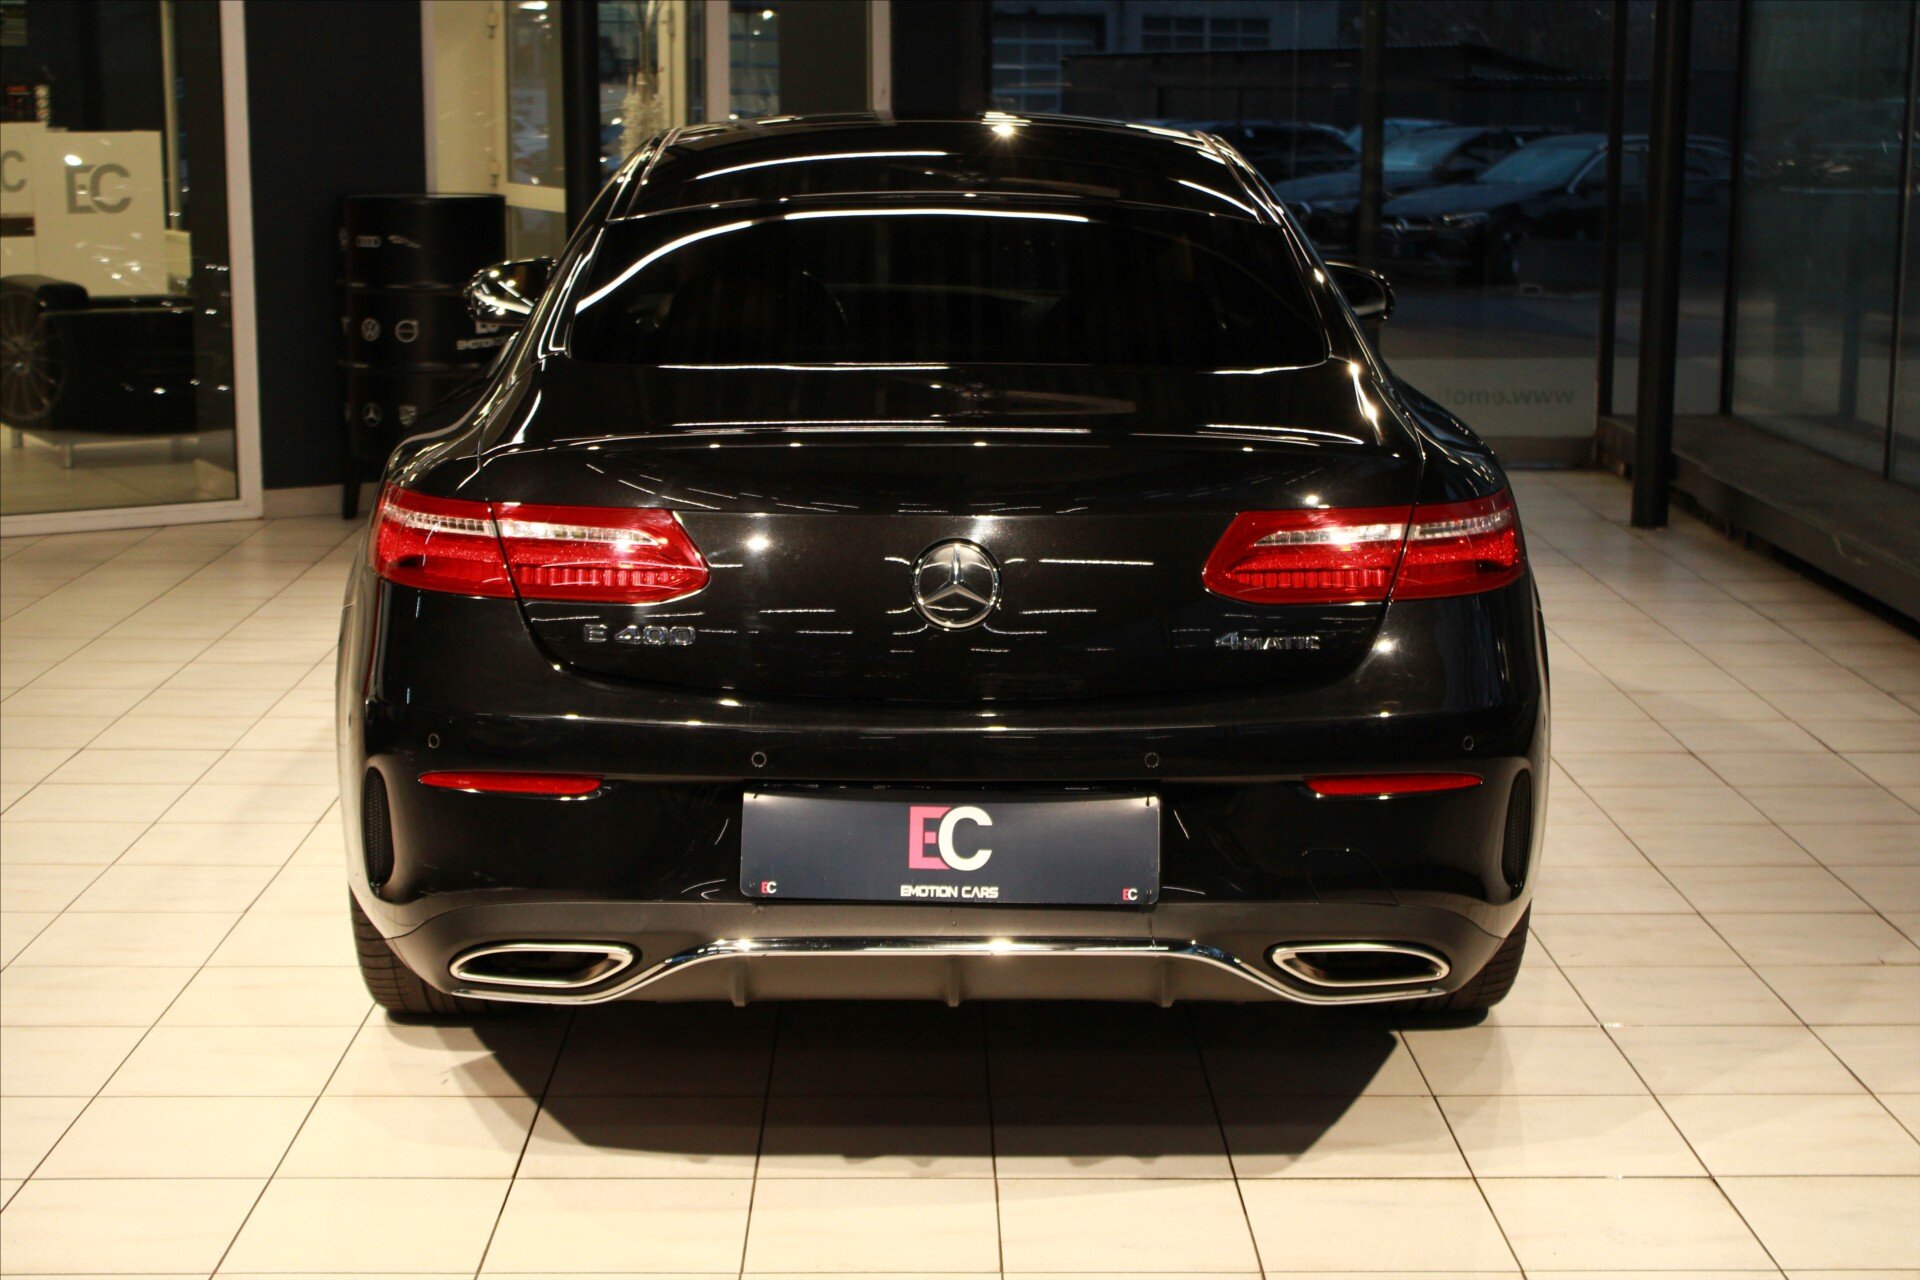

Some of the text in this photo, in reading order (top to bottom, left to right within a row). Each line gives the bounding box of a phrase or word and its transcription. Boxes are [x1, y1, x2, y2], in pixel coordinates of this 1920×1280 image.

[65, 163, 132, 213] EC
[583, 624, 696, 645] E 400
[1215, 632, 1320, 650] 4MATIC
[909, 805, 993, 872] EC
[761, 881, 777, 894] EC
[900, 885, 999, 899] EMOTION CARS
[1122, 888, 1138, 901] EC
